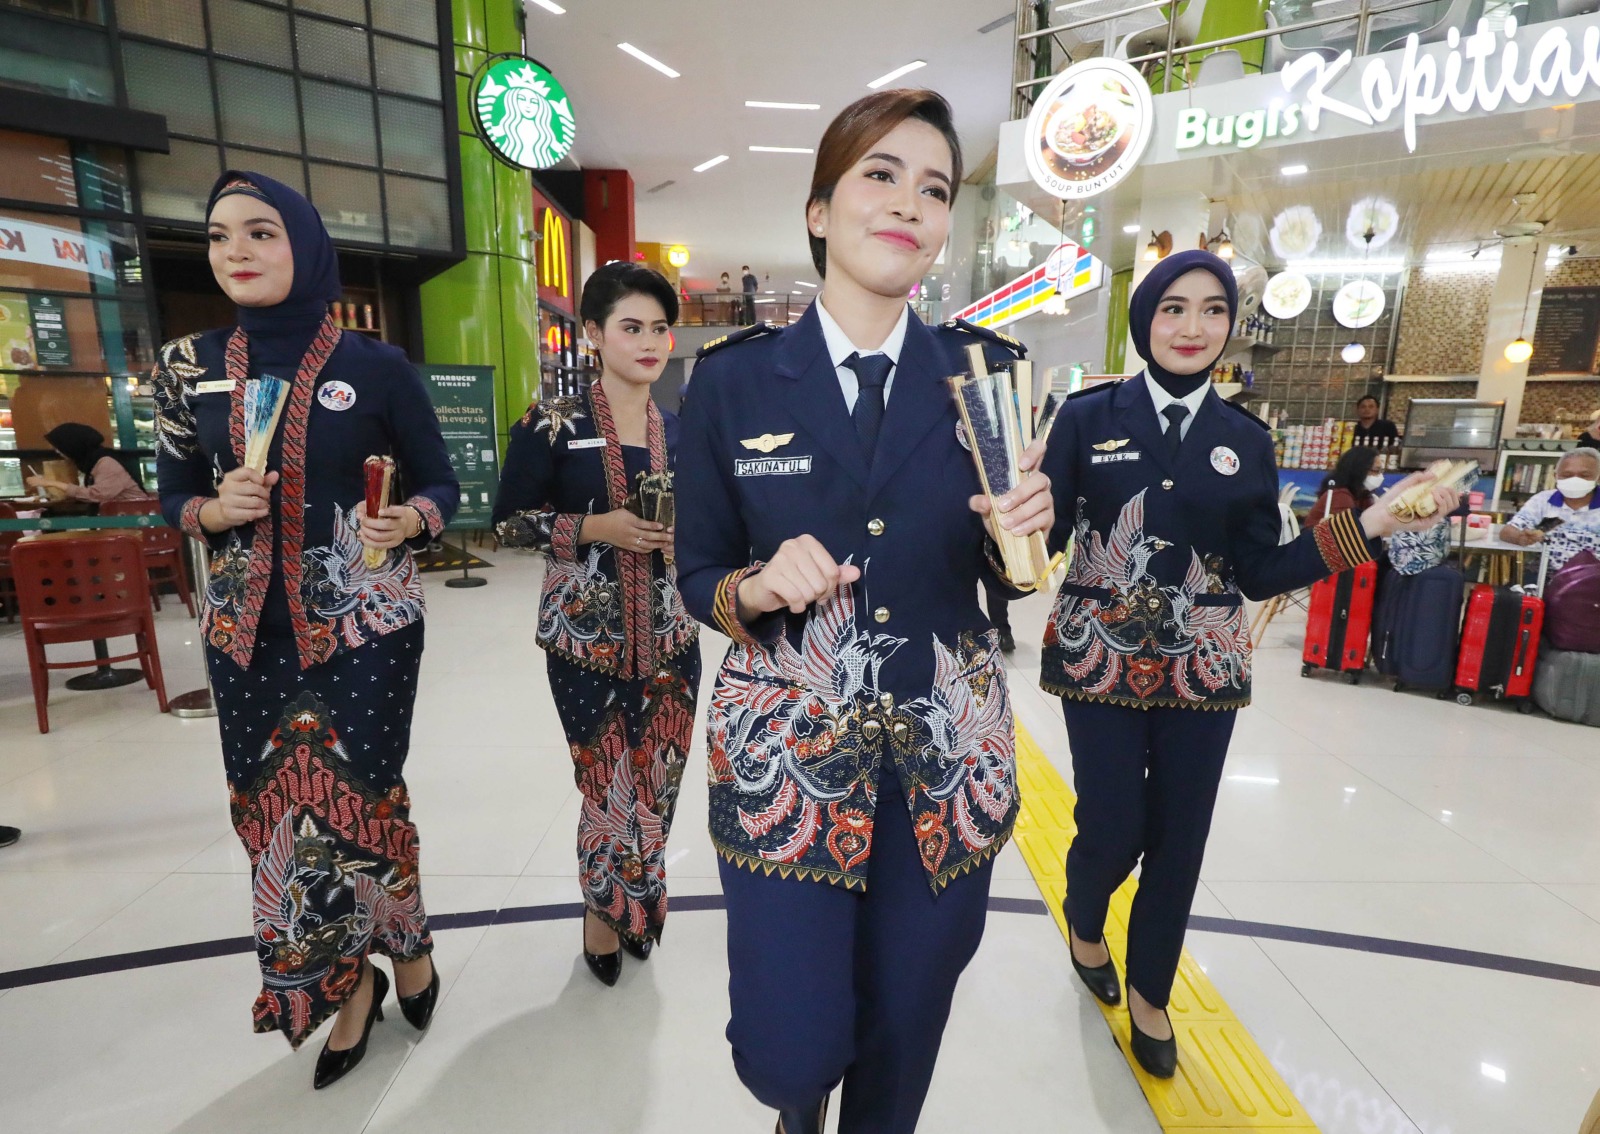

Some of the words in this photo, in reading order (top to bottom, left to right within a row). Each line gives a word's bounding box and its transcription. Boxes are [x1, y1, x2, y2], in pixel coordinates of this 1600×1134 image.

[1175, 97, 1301, 150] Bugis
[1044, 174, 1072, 193] SOUP
[1076, 163, 1124, 194] BUNTUT
[449, 416, 472, 424] every
[474, 414, 487, 424] sip
[741, 459, 806, 475] SAKINATUL
